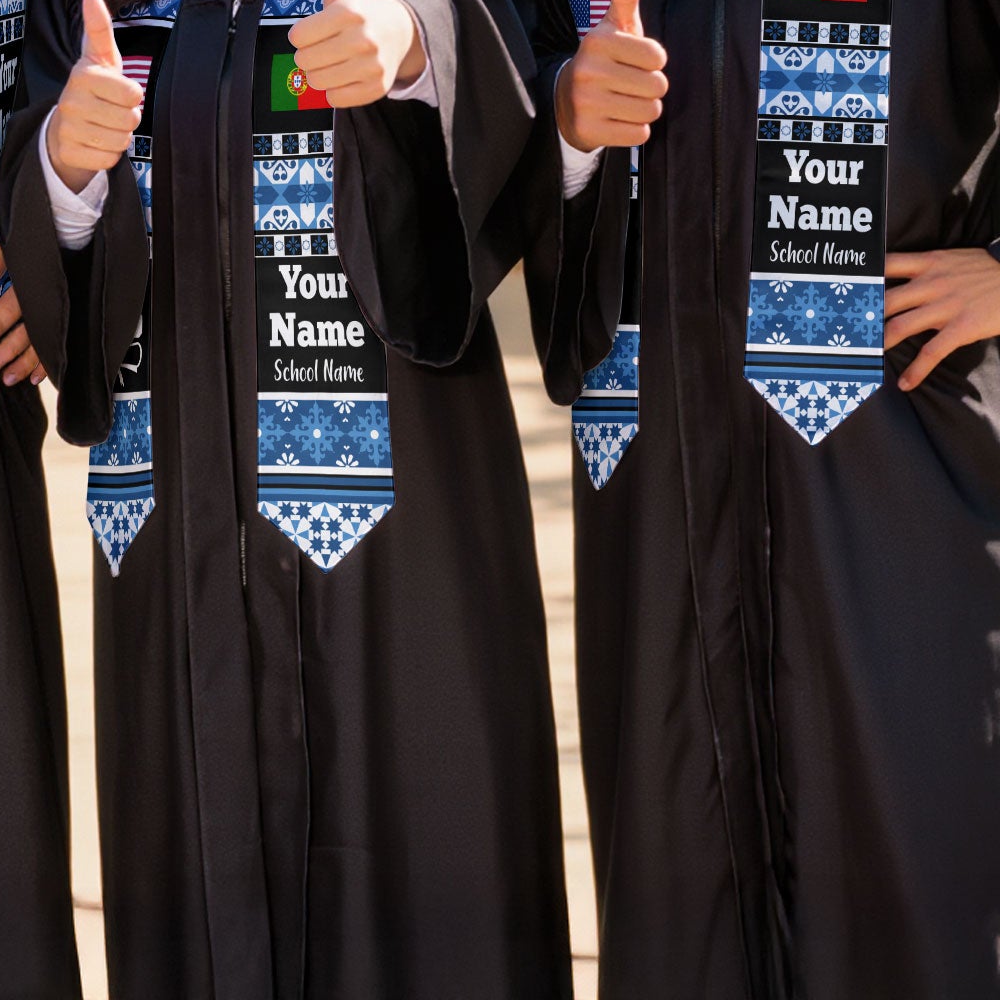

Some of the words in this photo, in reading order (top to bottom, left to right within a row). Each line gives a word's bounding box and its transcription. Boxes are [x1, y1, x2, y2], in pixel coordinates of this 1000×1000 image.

[783, 148, 864, 186] Your
[767, 194, 873, 233] Name
[769, 240, 819, 264] School
[822, 241, 866, 266] Name
[278, 264, 349, 300] Your
[268, 312, 366, 348] Name
[273, 358, 319, 382] School
[323, 358, 365, 383] Name
